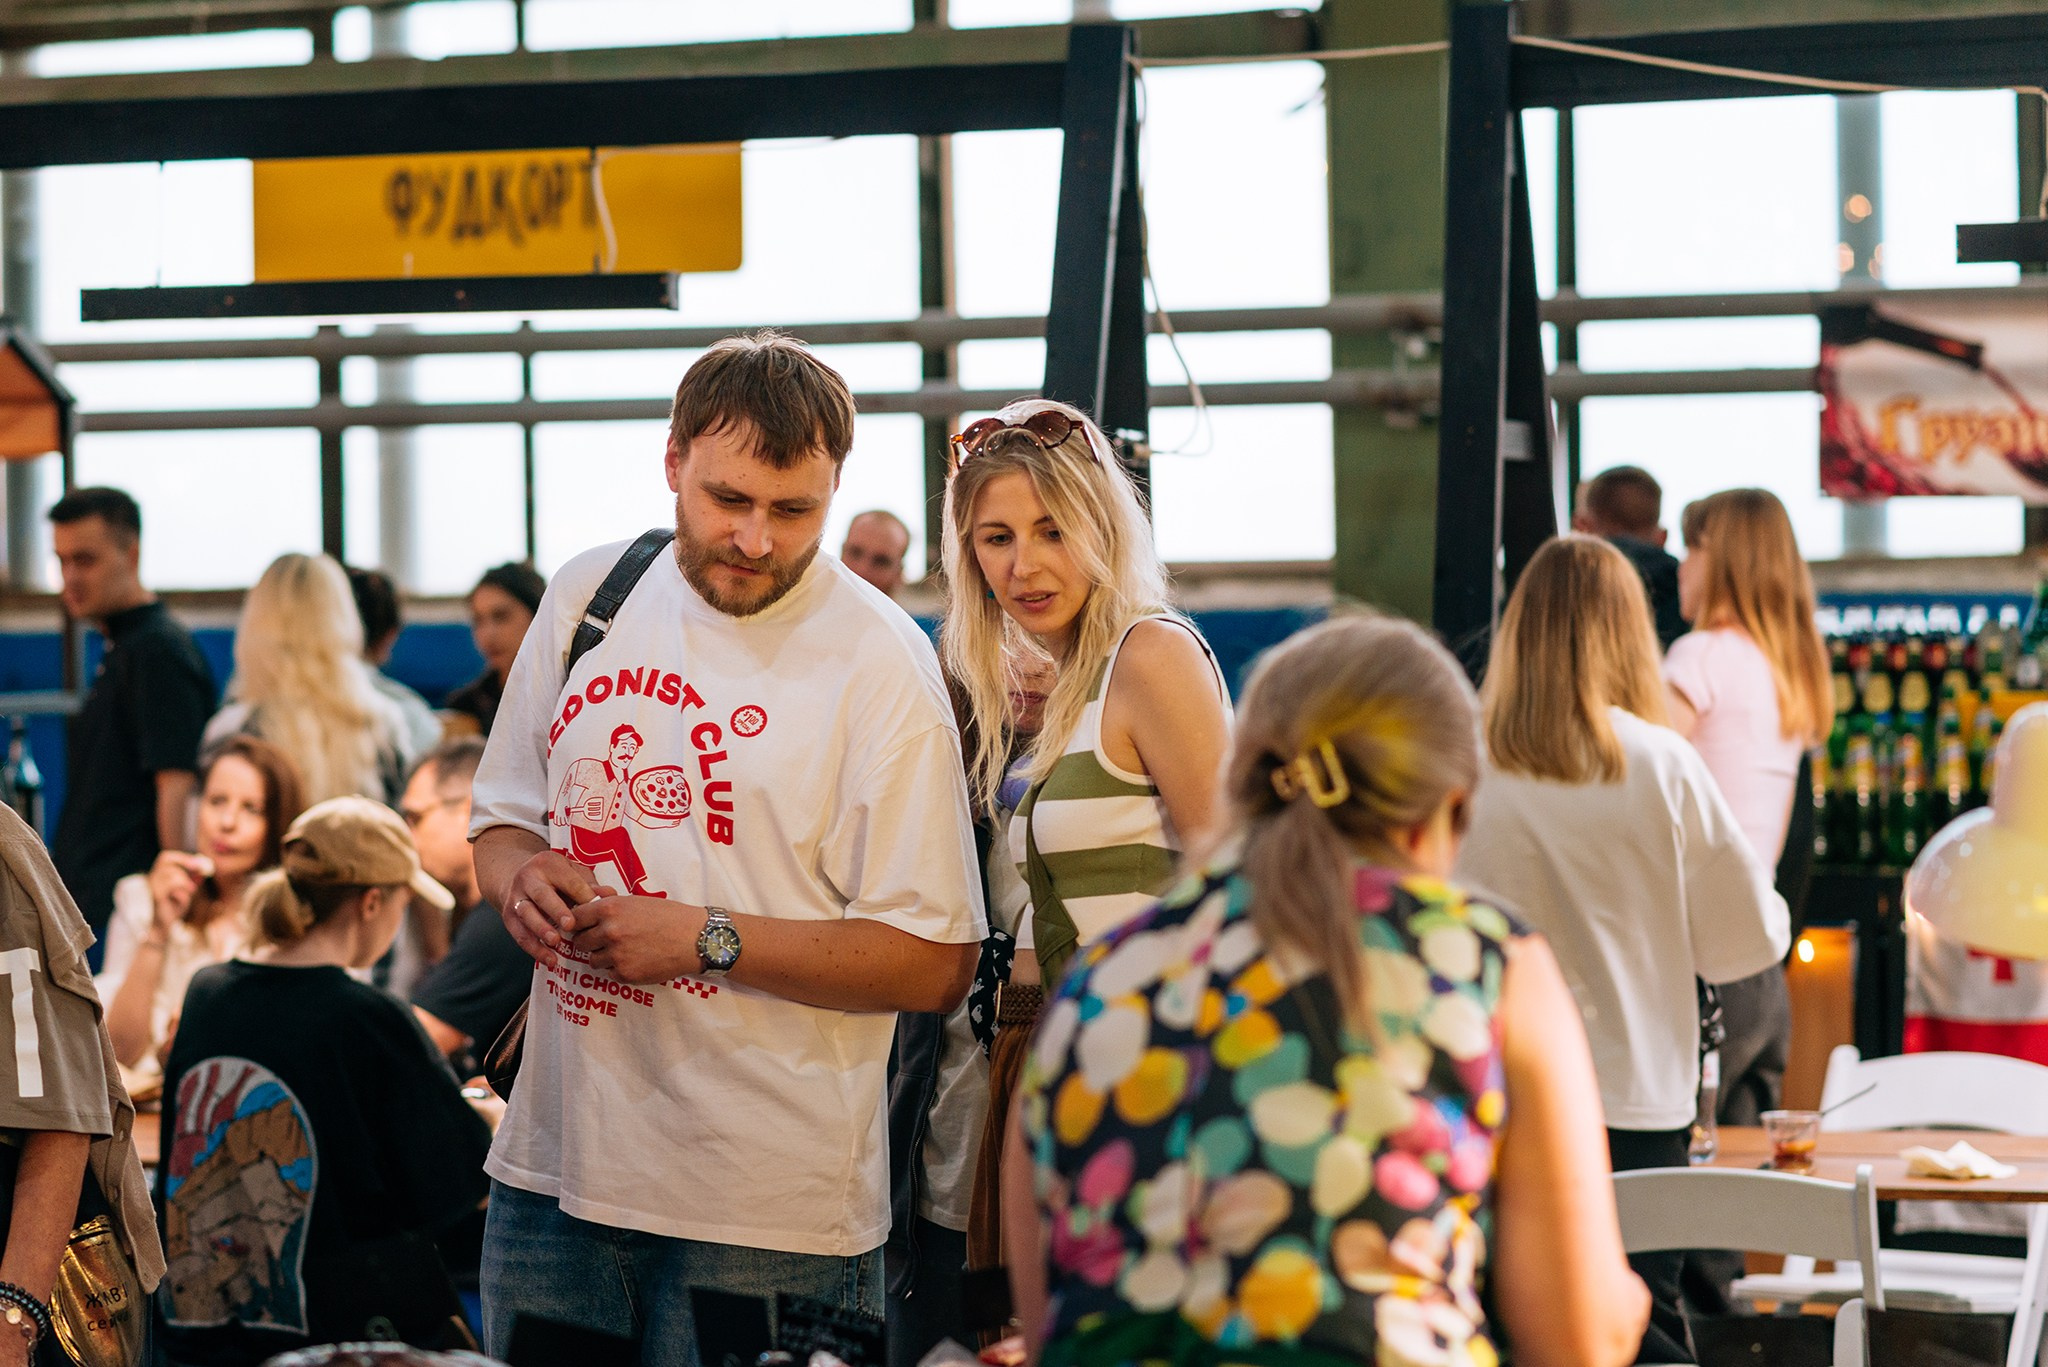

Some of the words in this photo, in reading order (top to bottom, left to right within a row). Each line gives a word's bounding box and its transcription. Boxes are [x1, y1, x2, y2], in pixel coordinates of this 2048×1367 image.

[387, 161, 598, 247] ФУДКОРТ
[548, 666, 706, 759] EDONIST
[690, 721, 734, 846] CLUB
[563, 1009, 590, 1027] 1953
[573, 971, 578, 985] I
[580, 973, 655, 1008] CHOOSE
